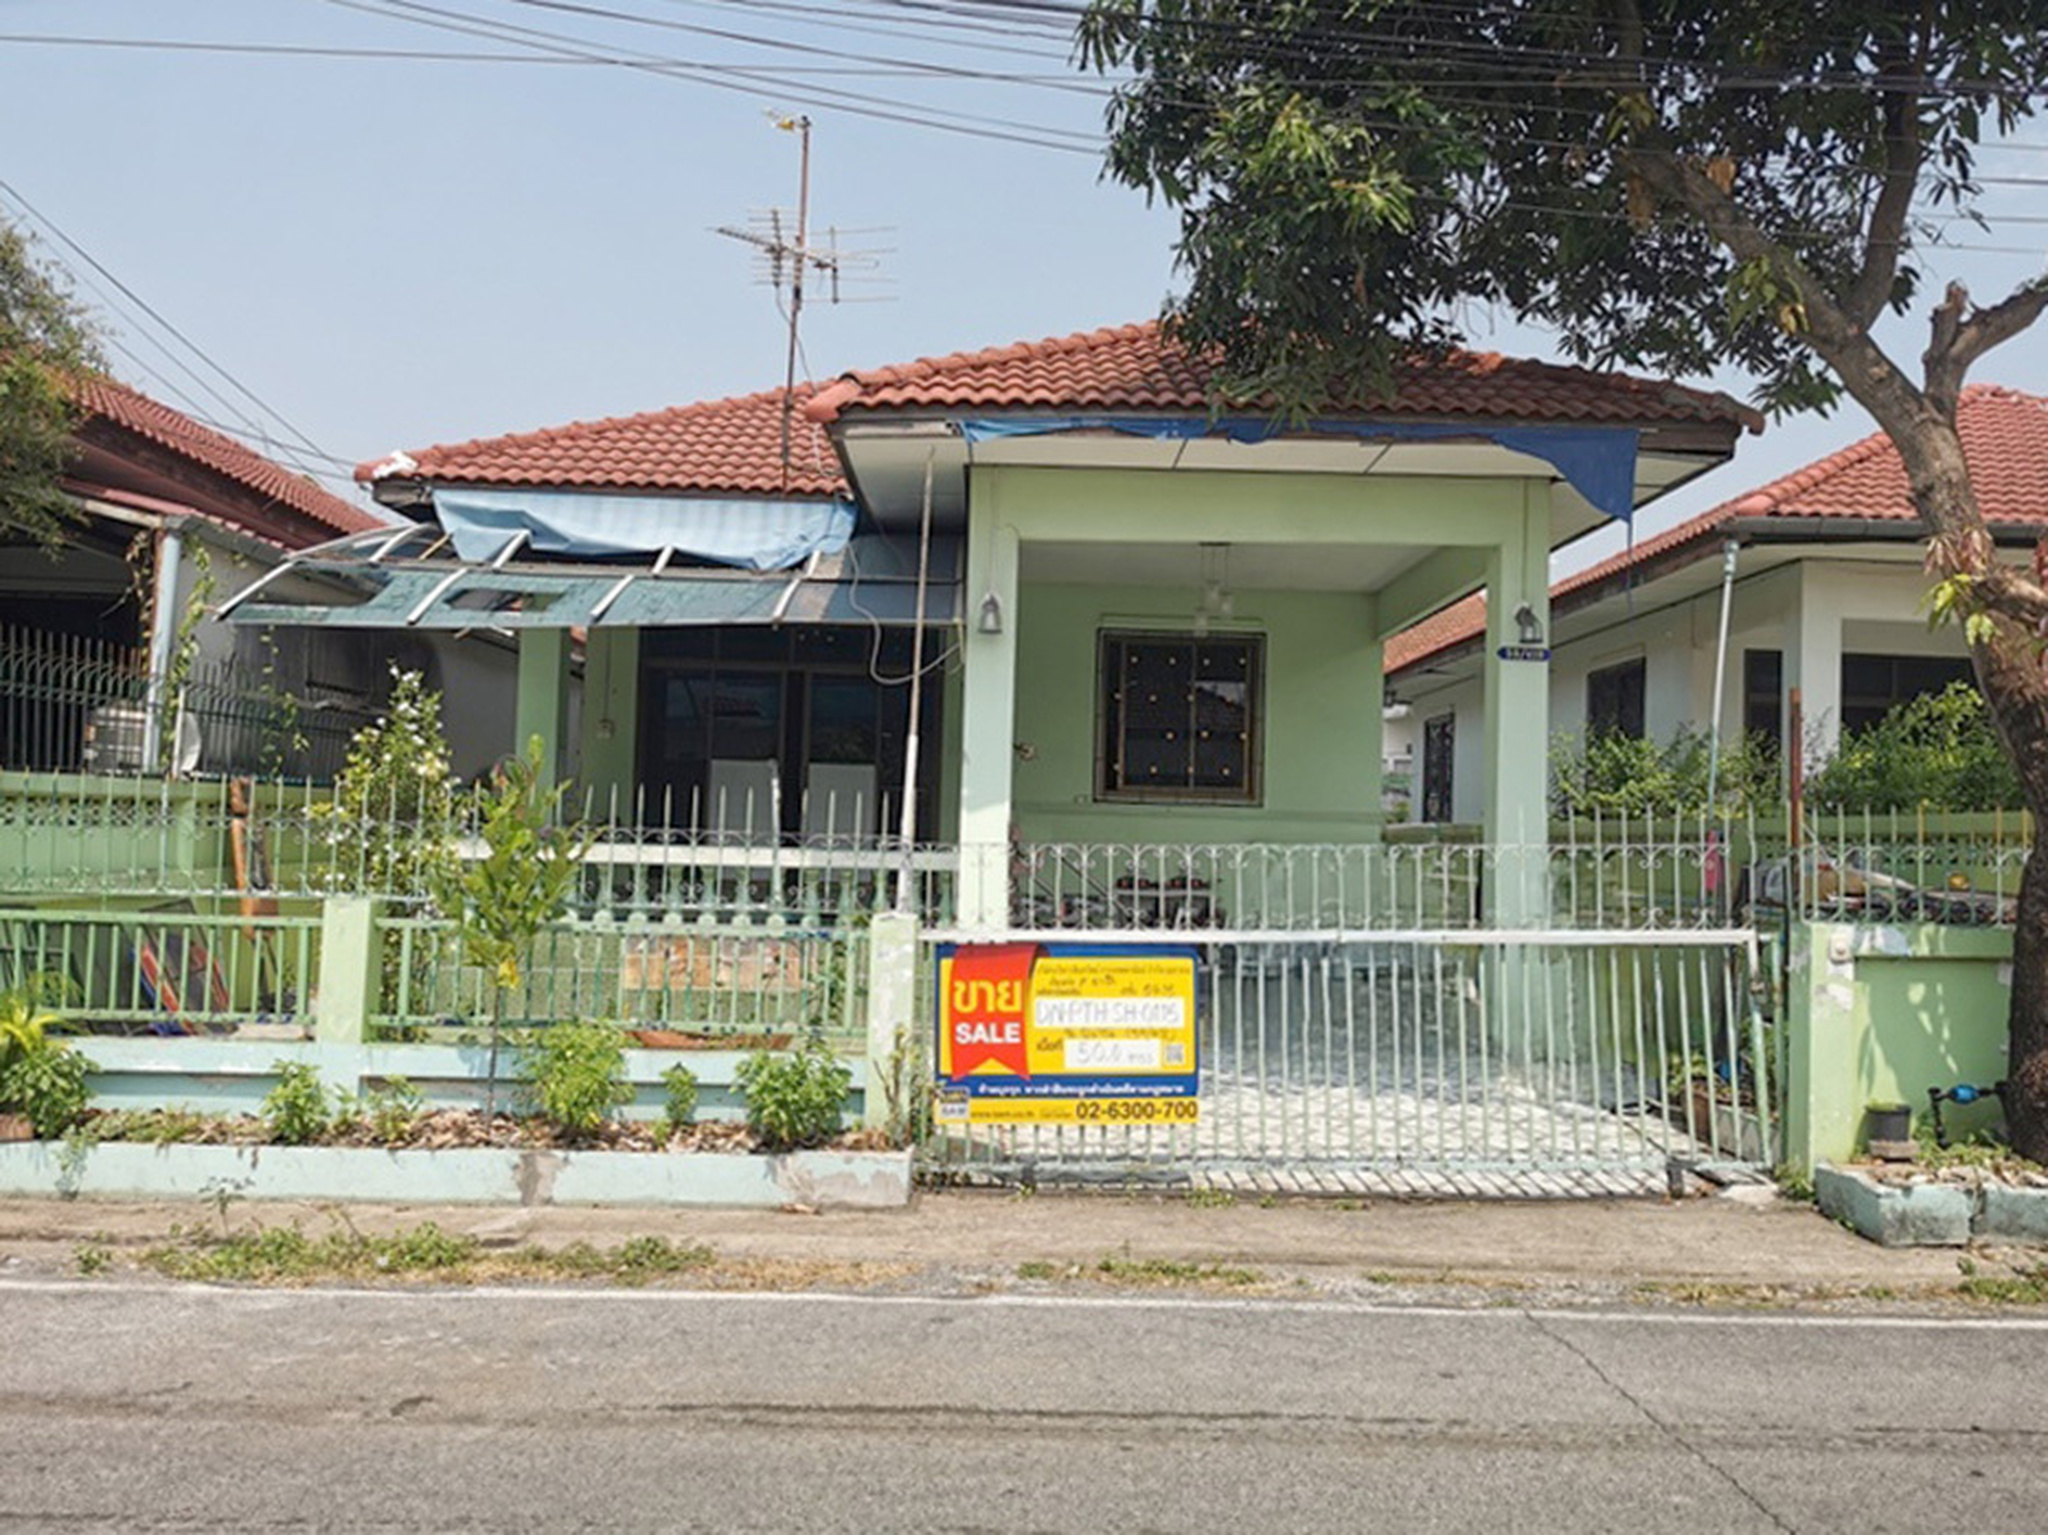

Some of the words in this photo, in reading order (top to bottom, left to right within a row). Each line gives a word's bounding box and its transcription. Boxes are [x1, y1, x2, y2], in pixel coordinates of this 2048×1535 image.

[953, 980, 1021, 1013] ขาย
[955, 1021, 1021, 1044] SALE
[1076, 1101, 1197, 1119] 02-6300-700
